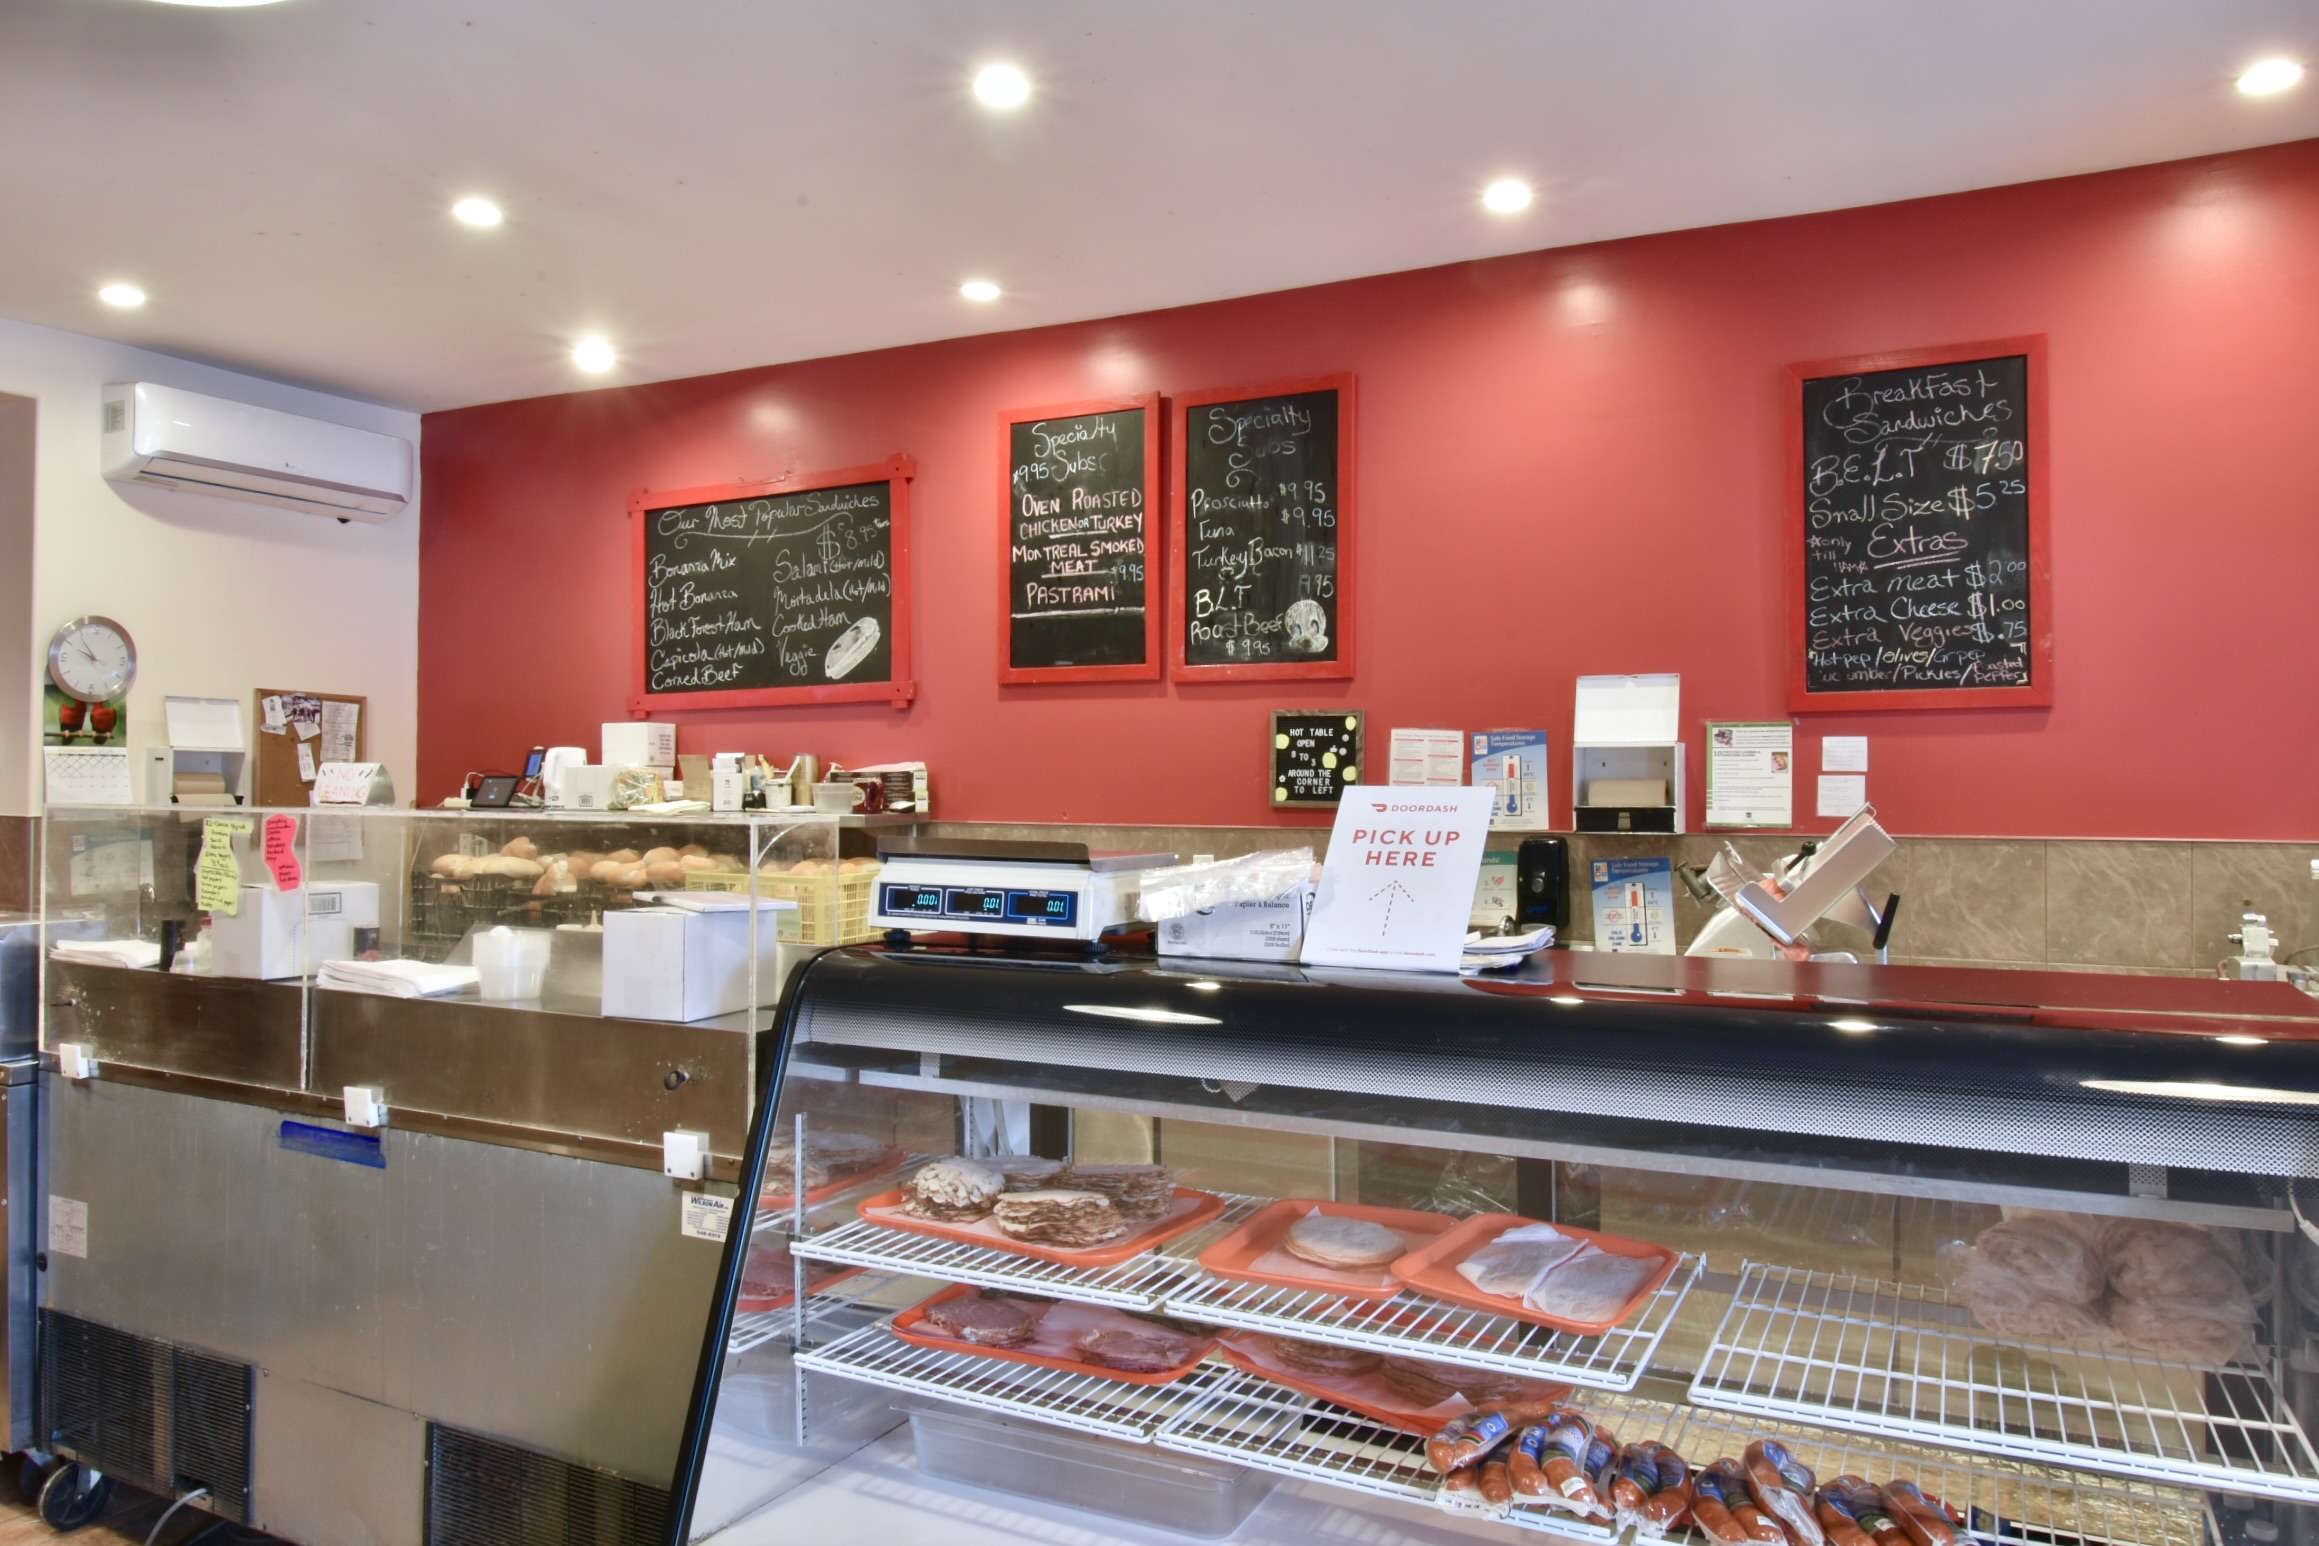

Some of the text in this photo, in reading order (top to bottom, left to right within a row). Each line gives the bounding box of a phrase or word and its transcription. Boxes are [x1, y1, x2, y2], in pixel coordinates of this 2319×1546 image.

[1208, 405, 1311, 447] Specialty
[1844, 400, 2012, 444] Sandwiches
[1032, 415, 1116, 458] Specialty
[1072, 488, 1142, 511] ROASTED
[1809, 494, 1875, 529] Small
[1880, 493, 1946, 523] Size
[658, 511, 699, 535] Our
[705, 506, 748, 533] Most
[749, 500, 803, 530] Popular
[1020, 518, 1078, 540] CHICKEN
[1090, 512, 1143, 533] TURKEY
[1090, 538, 1145, 557] SMOKED
[1248, 537, 1292, 566] Bacon
[1867, 523, 1969, 558] Extras
[648, 548, 737, 588] Bonanza Mix
[1051, 560, 1099, 574] MEAT
[1810, 576, 1879, 602] Extra
[1887, 568, 1961, 593] meat
[650, 581, 738, 617] Hot Bonanza
[1810, 605, 1888, 627] Extra
[1890, 596, 1962, 621] Cheese
[650, 617, 691, 646] Black
[724, 611, 762, 634] Ham
[820, 608, 852, 629] Ham
[1813, 627, 1882, 650] Extra
[1898, 623, 1972, 649] Veggies
[1290, 728, 1334, 737] HOT TABLE
[1296, 739, 1315, 748] OPEN
[1288, 769, 1332, 777] AROUND THE
[1296, 778, 1330, 786] CORNER
[1294, 786, 1333, 794] TO LEFT
[1391, 804, 1458, 813] DOORDASH
[1352, 829, 1461, 846] PICK UP
[1365, 850, 1437, 867] HERE
